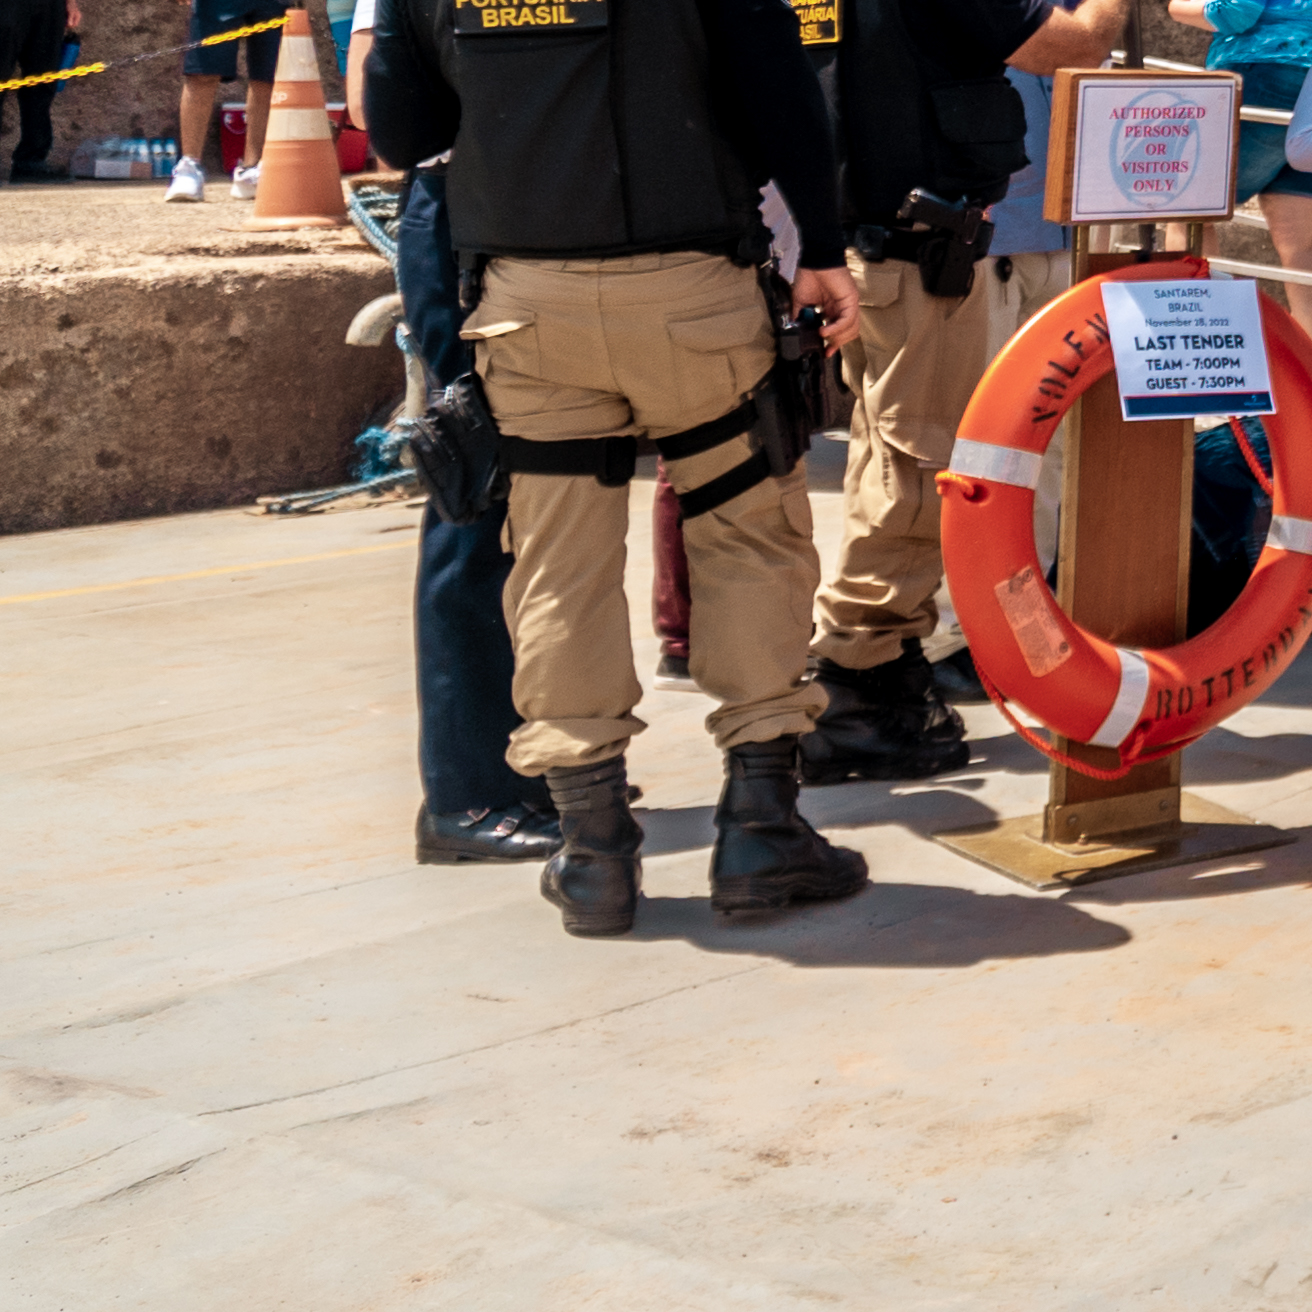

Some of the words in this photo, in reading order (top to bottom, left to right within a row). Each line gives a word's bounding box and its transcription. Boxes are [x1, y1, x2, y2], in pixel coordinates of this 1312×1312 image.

[482, 5, 575, 28] BRASIL
[1109, 106, 1206, 120] AUTHORIZED
[1125, 125, 1190, 138] PERSONS
[1145, 143, 1167, 156] OR
[1121, 160, 1189, 174] VISITORS
[1133, 179, 1175, 192] ONLY
[1154, 288, 1211, 299] SANTAREM,
[1168, 302, 1203, 313] BRAZIL
[1145, 318, 1192, 327] November
[1209, 318, 1229, 327] 2022
[1134, 335, 1176, 351] LAST
[1180, 334, 1245, 350] TENDER
[1145, 359, 1182, 371] TEAM
[1192, 357, 1241, 369] 7:00PM
[1146, 377, 1188, 390] GUEST
[1198, 376, 1245, 388] 7:30PM
